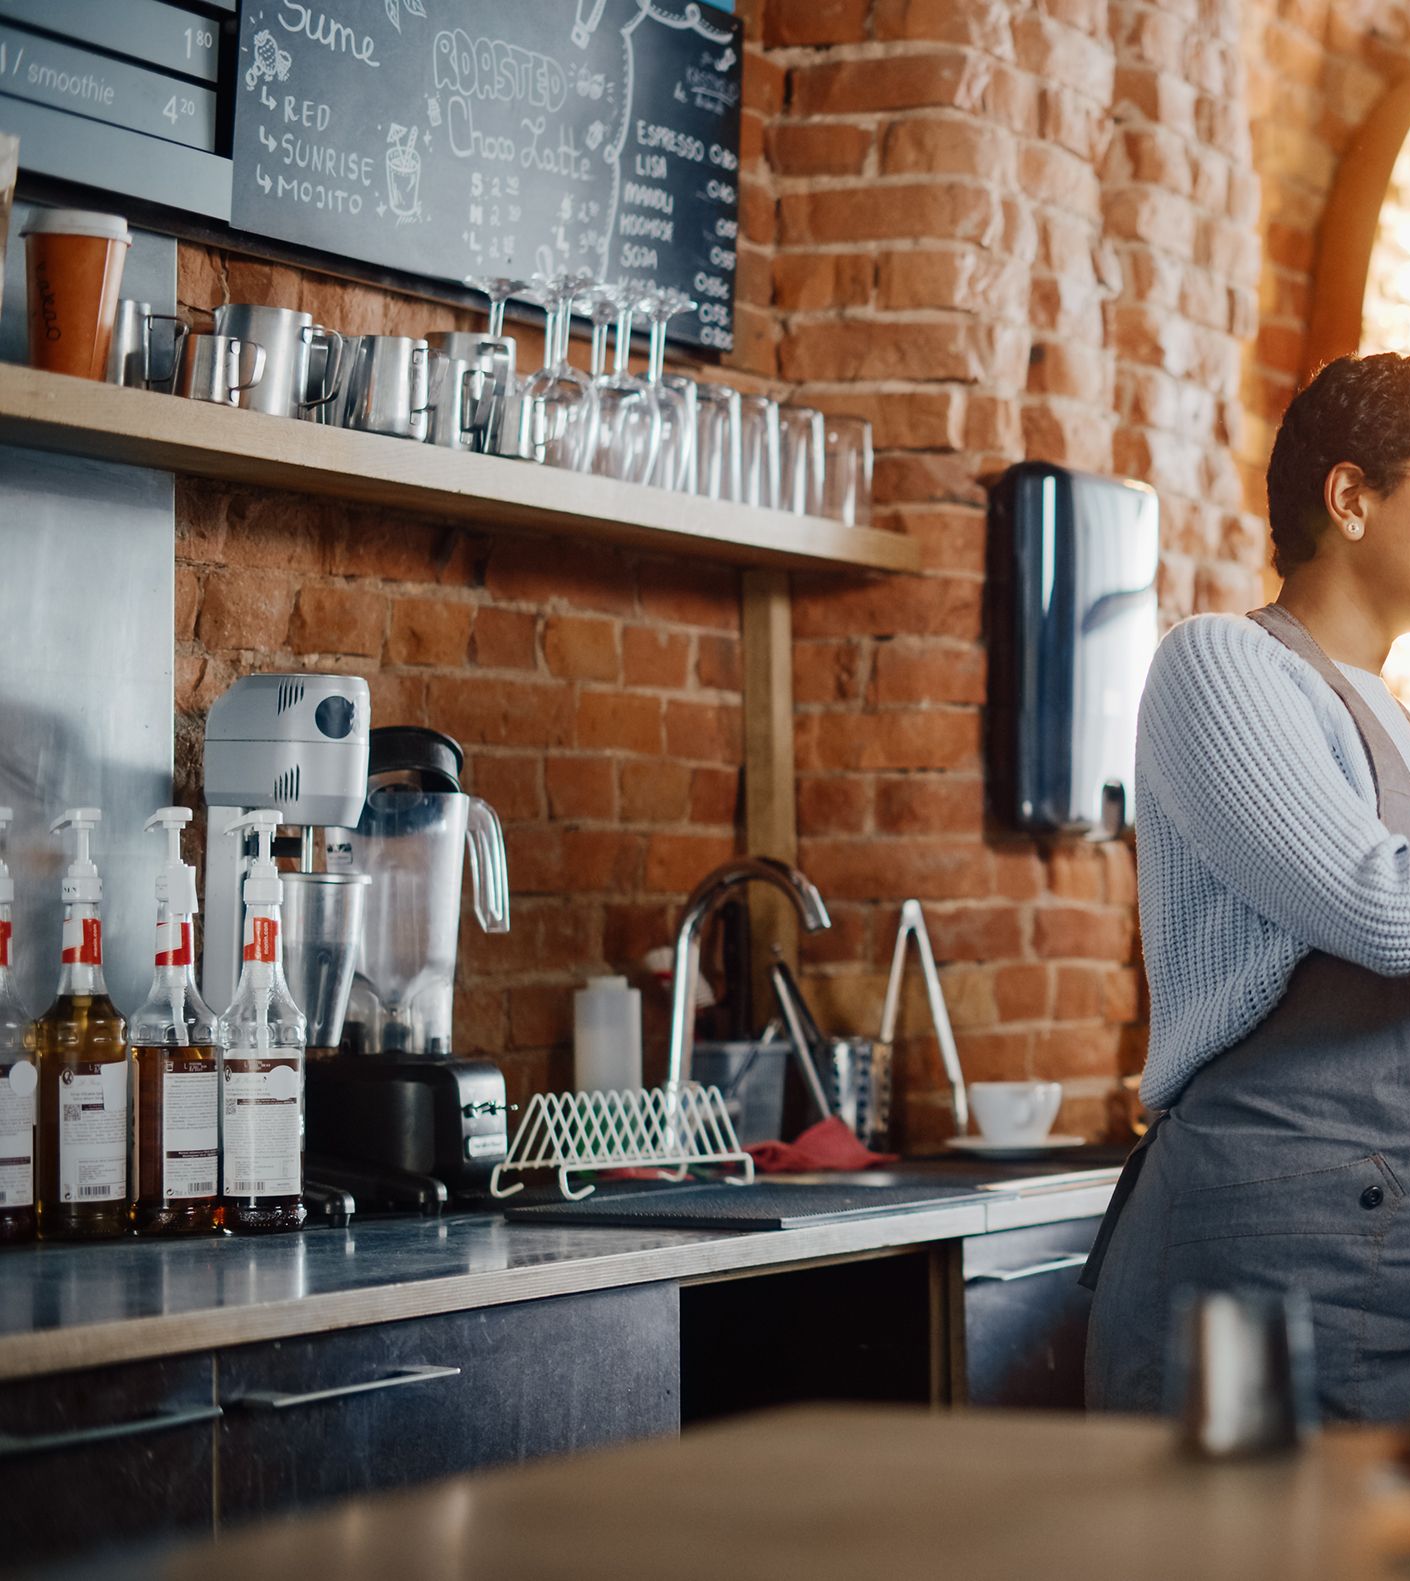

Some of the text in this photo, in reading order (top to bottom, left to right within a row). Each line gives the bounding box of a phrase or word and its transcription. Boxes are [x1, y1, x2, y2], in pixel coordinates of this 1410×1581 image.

[27, 62, 115, 105] smoothie
[433, 28, 567, 113] ROASTED
[284, 95, 331, 131] RED
[281, 133, 375, 187] SUNRISE
[520, 115, 593, 181] Latte
[637, 119, 705, 162] ESPRESSO
[277, 175, 363, 215] MOJITO
